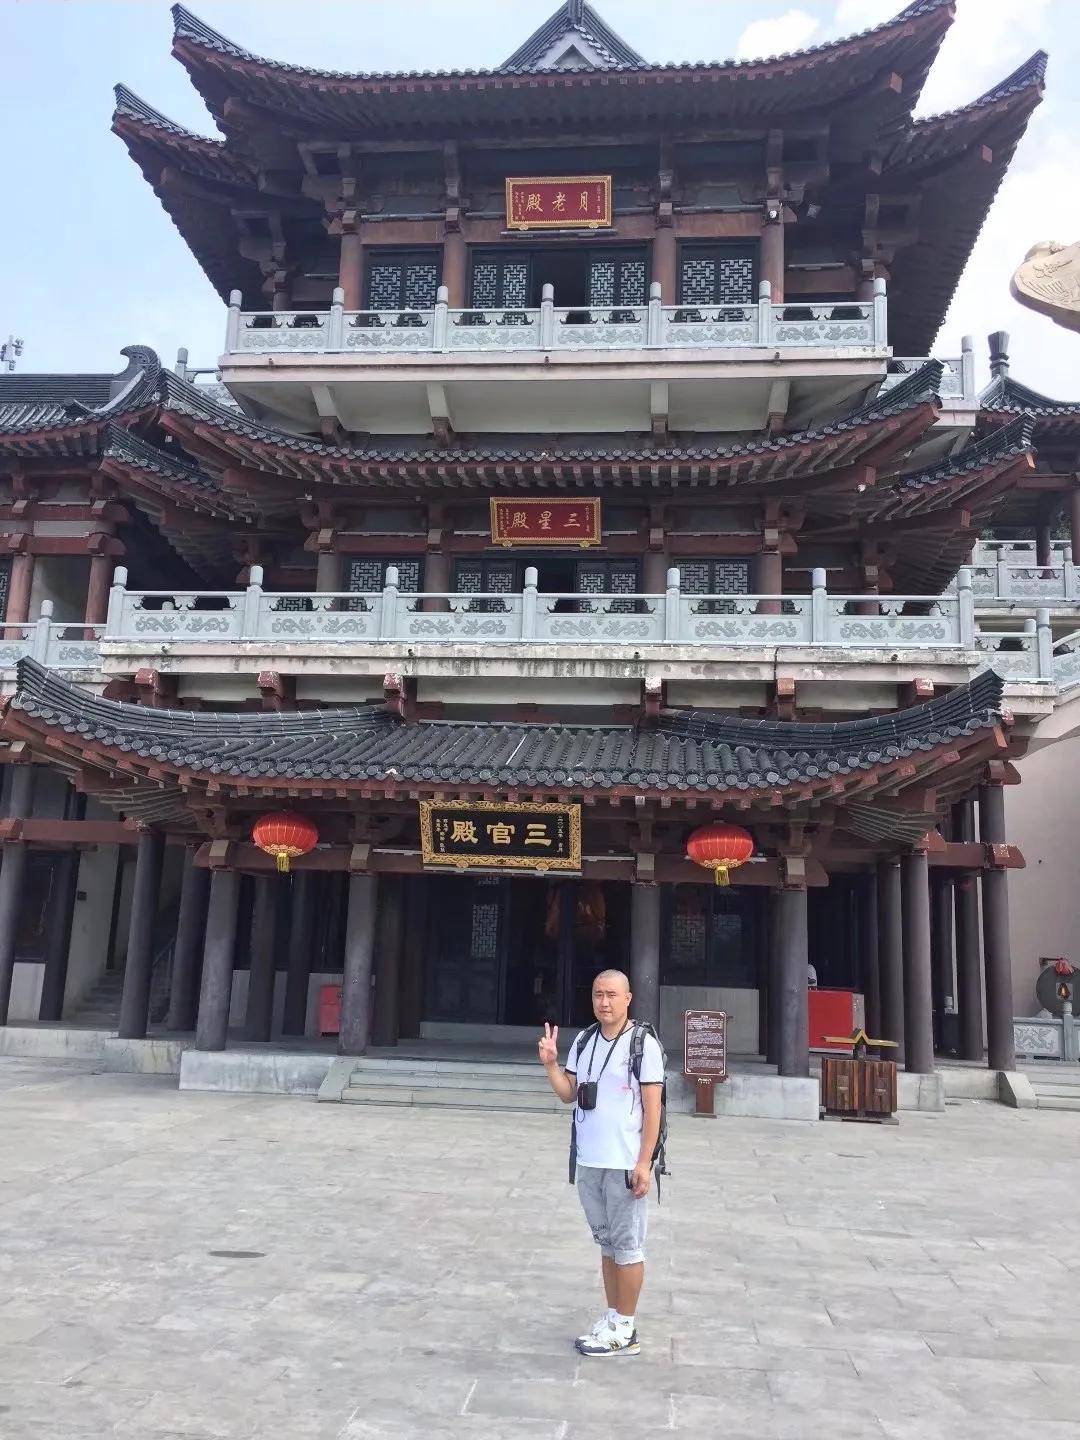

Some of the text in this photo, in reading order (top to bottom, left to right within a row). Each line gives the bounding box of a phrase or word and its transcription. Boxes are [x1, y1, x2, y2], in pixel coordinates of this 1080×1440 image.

[510, 510, 581, 530] 三星殿
[450, 820, 552, 847] 三官殿
